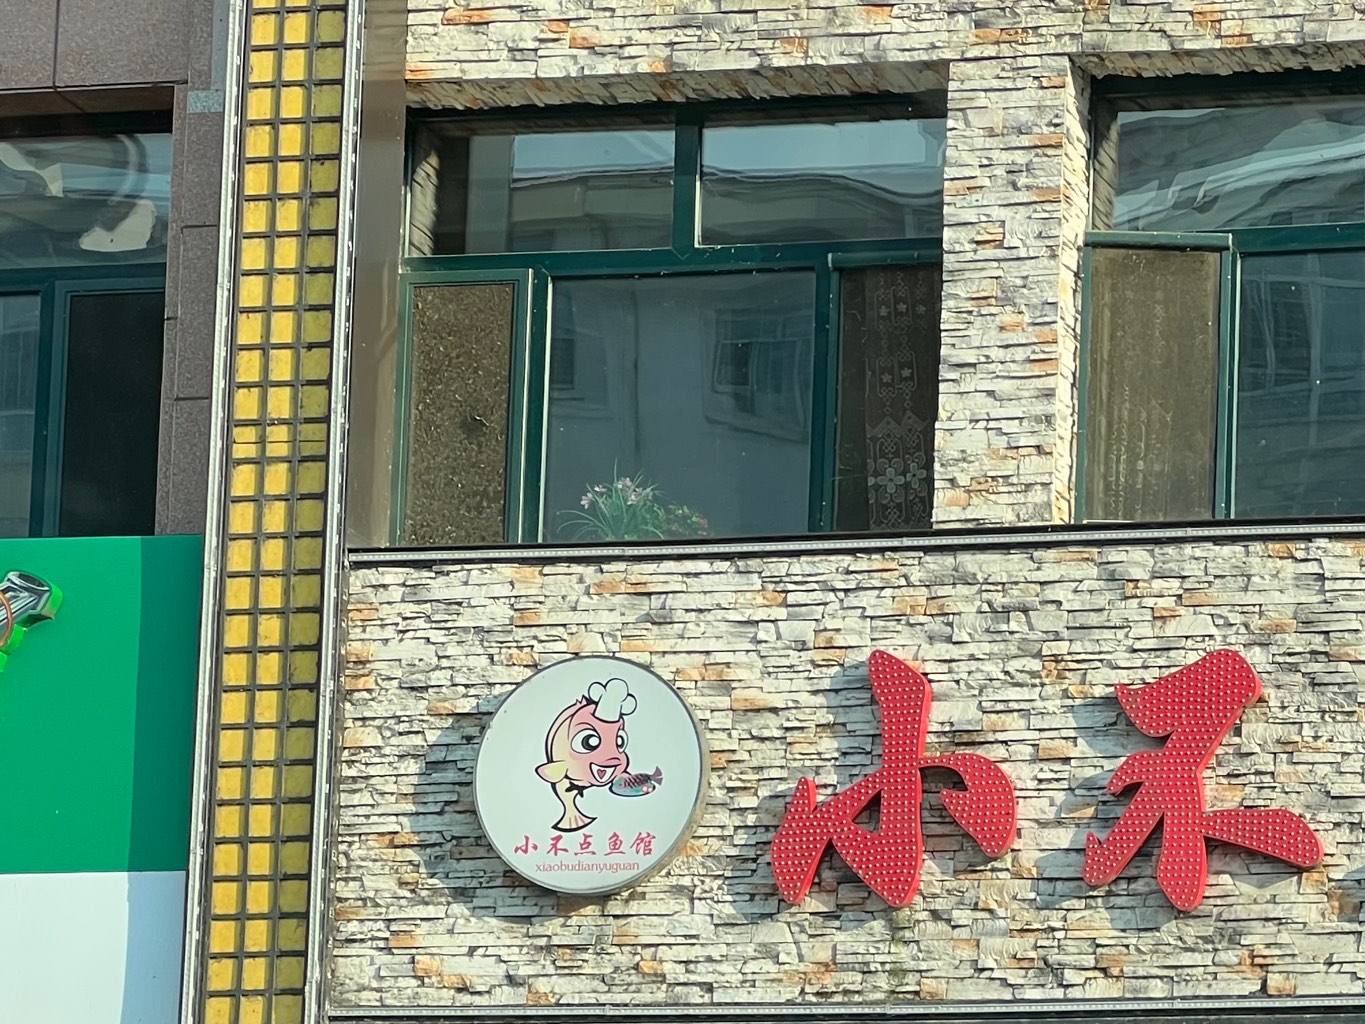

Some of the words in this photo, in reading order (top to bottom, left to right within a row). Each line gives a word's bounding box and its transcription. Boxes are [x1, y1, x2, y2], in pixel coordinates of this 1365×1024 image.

[513, 831, 657, 856] 小不点鱼馆
[535, 860, 640, 874] xiaobudianyuguan
